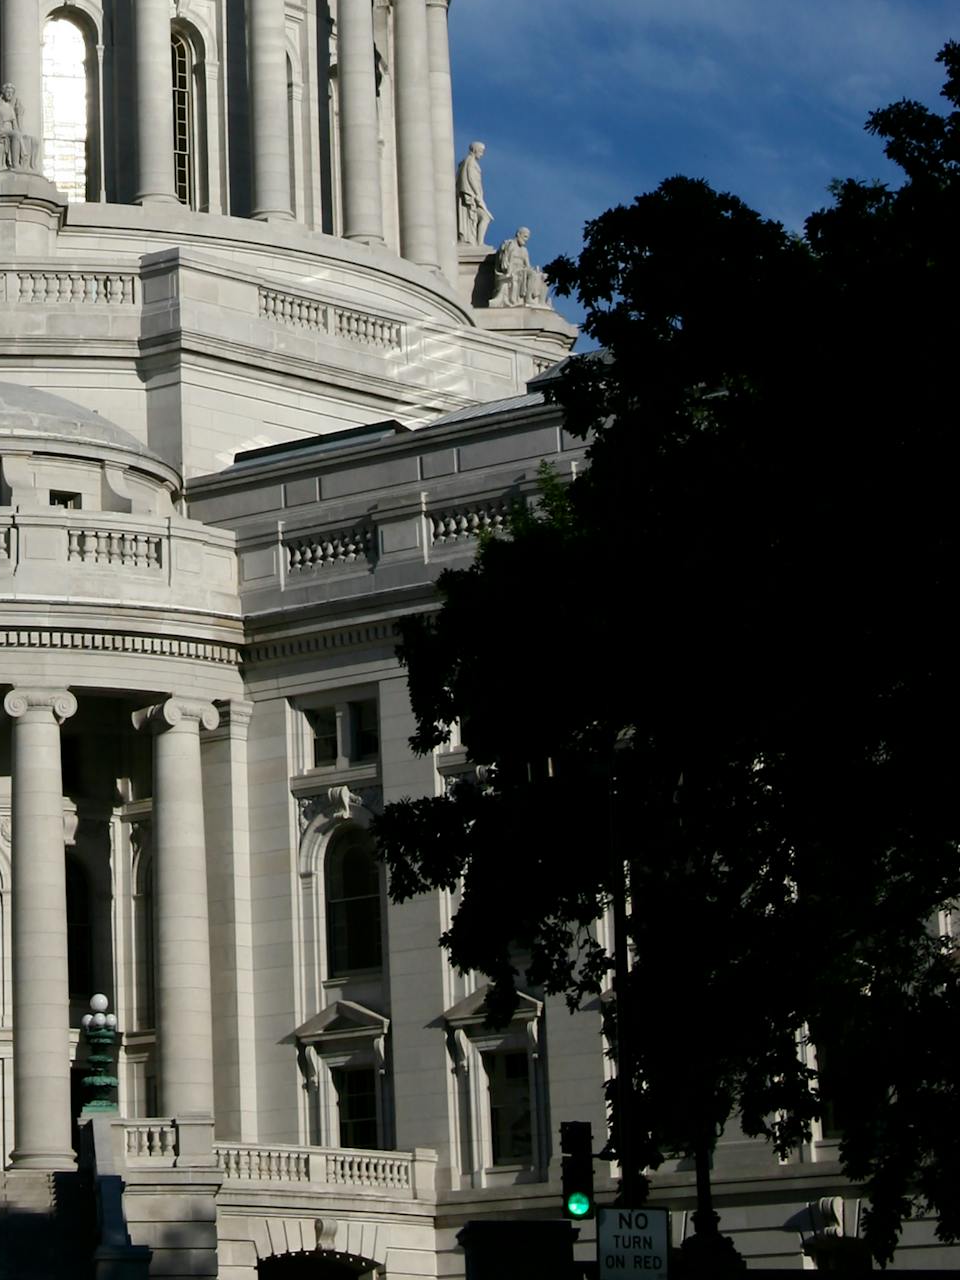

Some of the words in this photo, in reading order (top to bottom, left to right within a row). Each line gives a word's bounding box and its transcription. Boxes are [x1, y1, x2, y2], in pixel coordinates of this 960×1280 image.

[618, 1212, 648, 1230] NO
[613, 1234, 653, 1250] TURN
[605, 1255, 625, 1269] ON
[633, 1255, 662, 1270] RED
